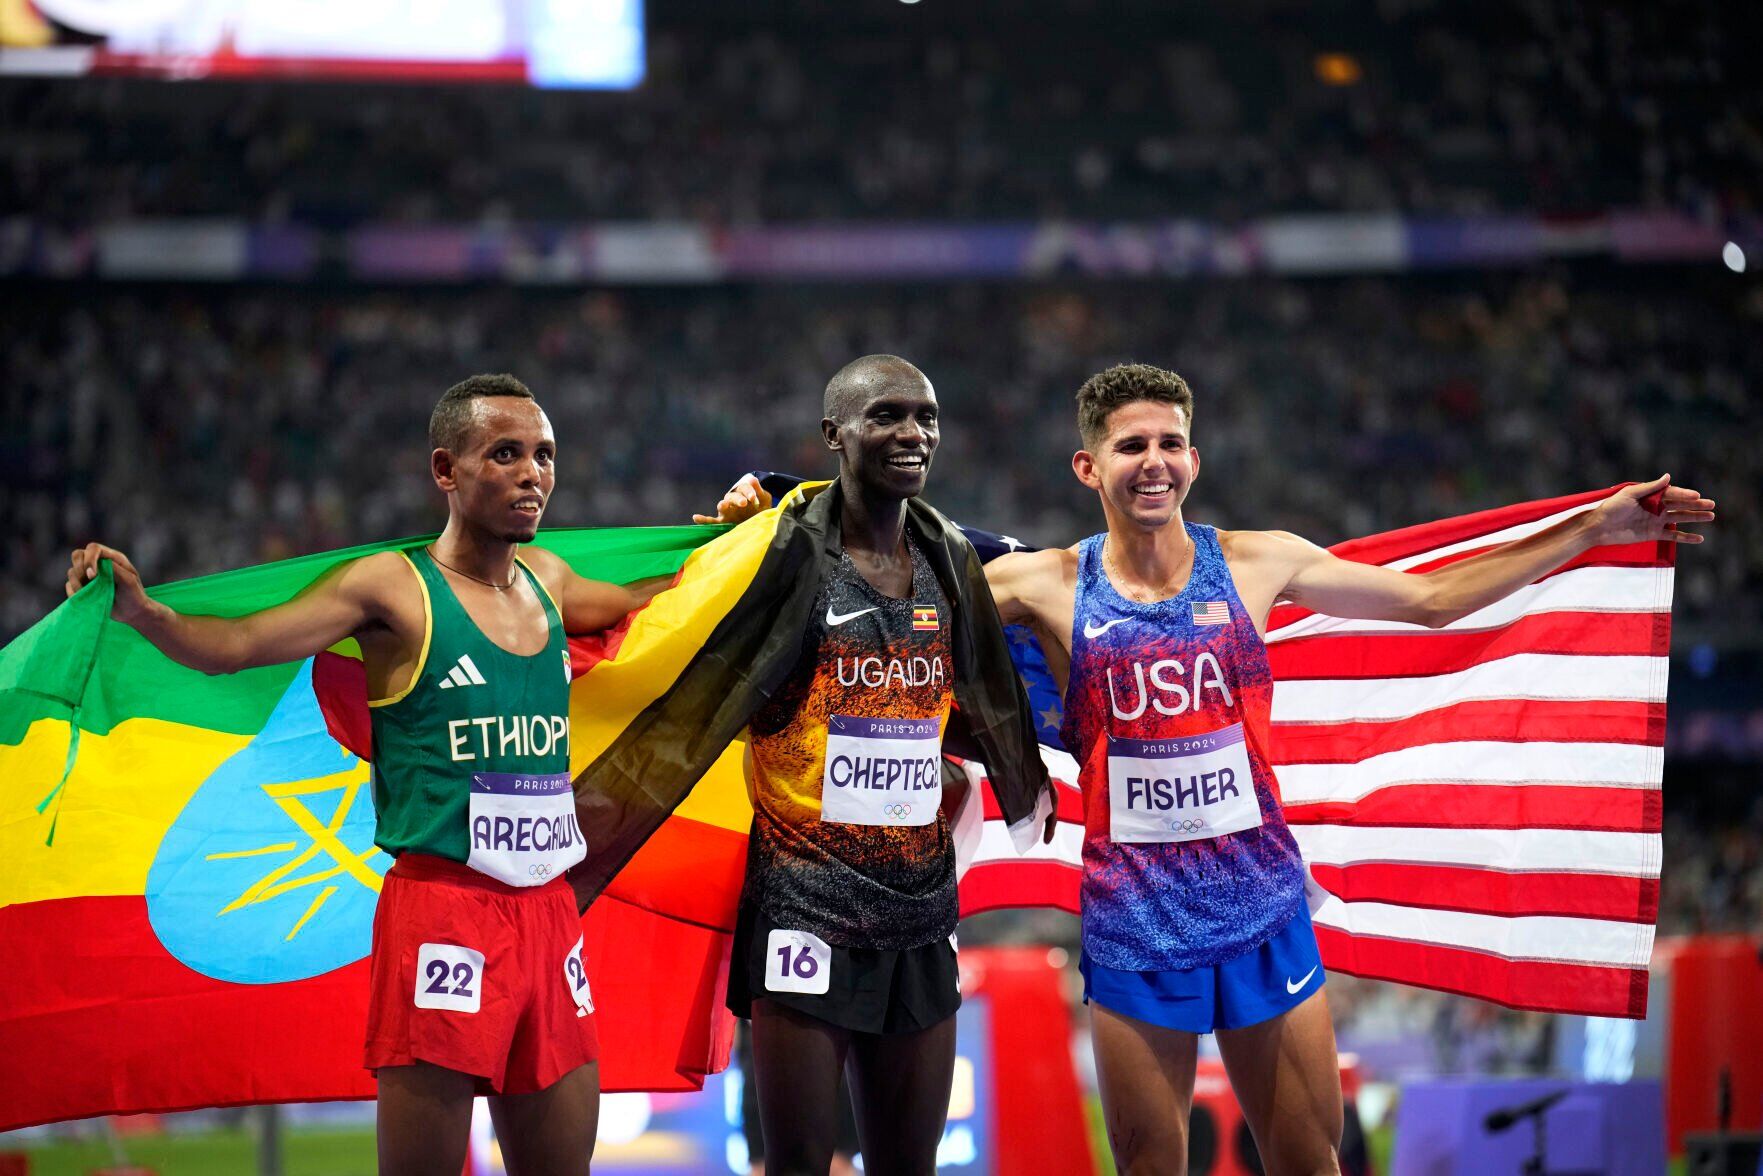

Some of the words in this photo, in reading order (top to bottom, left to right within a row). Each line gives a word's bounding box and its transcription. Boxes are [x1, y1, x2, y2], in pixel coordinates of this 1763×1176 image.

[837, 656, 944, 688] UGANDA
[1107, 652, 1234, 721] USA
[870, 723, 904, 735] PARIS
[908, 724, 933, 735] 2024
[1142, 743, 1179, 754] PARIS
[1183, 738, 1216, 752] 2024
[515, 779, 548, 790] PARIS
[1126, 767, 1239, 811] FISHER
[473, 813, 583, 852] AREGAWI
[424, 959, 474, 998] 22
[777, 945, 818, 979] 16
